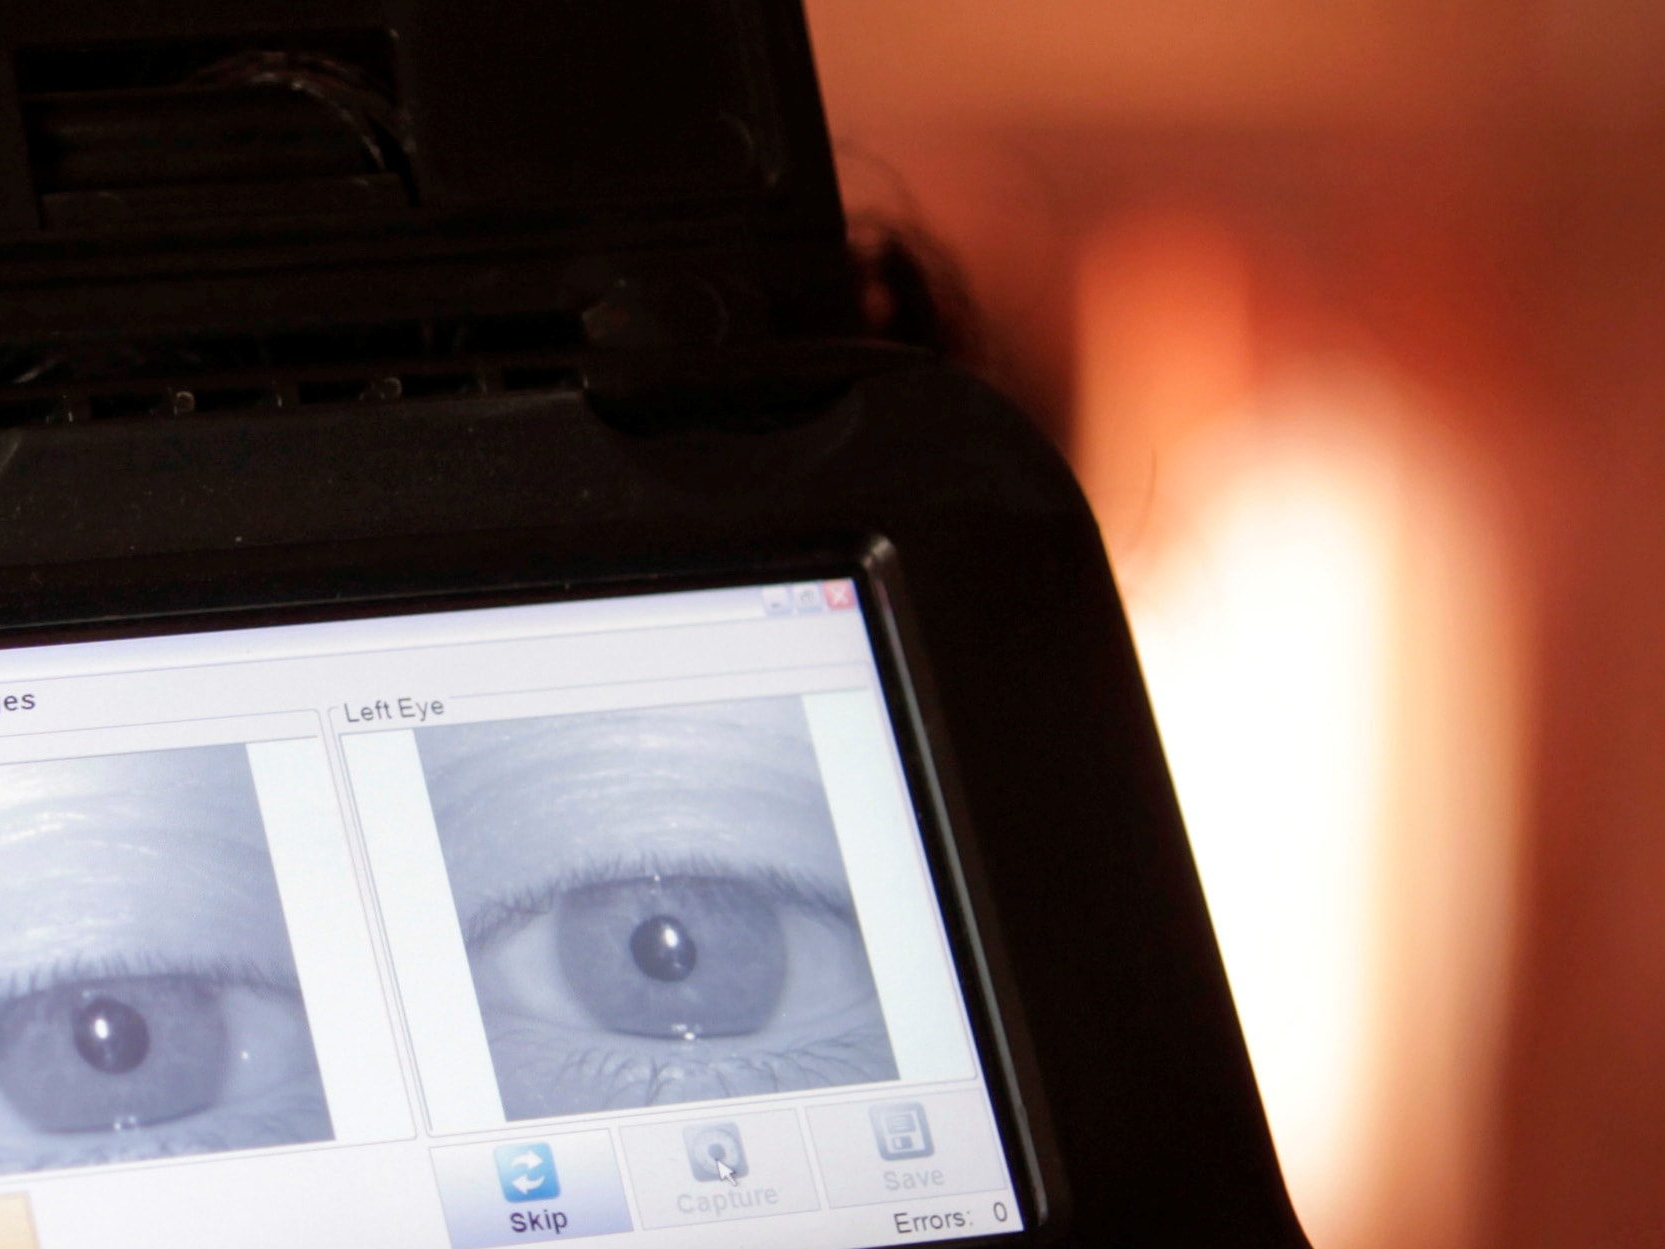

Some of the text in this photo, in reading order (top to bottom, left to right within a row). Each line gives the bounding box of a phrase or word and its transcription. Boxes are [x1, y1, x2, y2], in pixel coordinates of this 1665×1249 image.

[343, 697, 446, 724] Left Eye
[883, 1167, 946, 1192] Save
[676, 1185, 780, 1218] Capture
[509, 1208, 569, 1236] Skip
[893, 1201, 1010, 1236] Errors: 0
